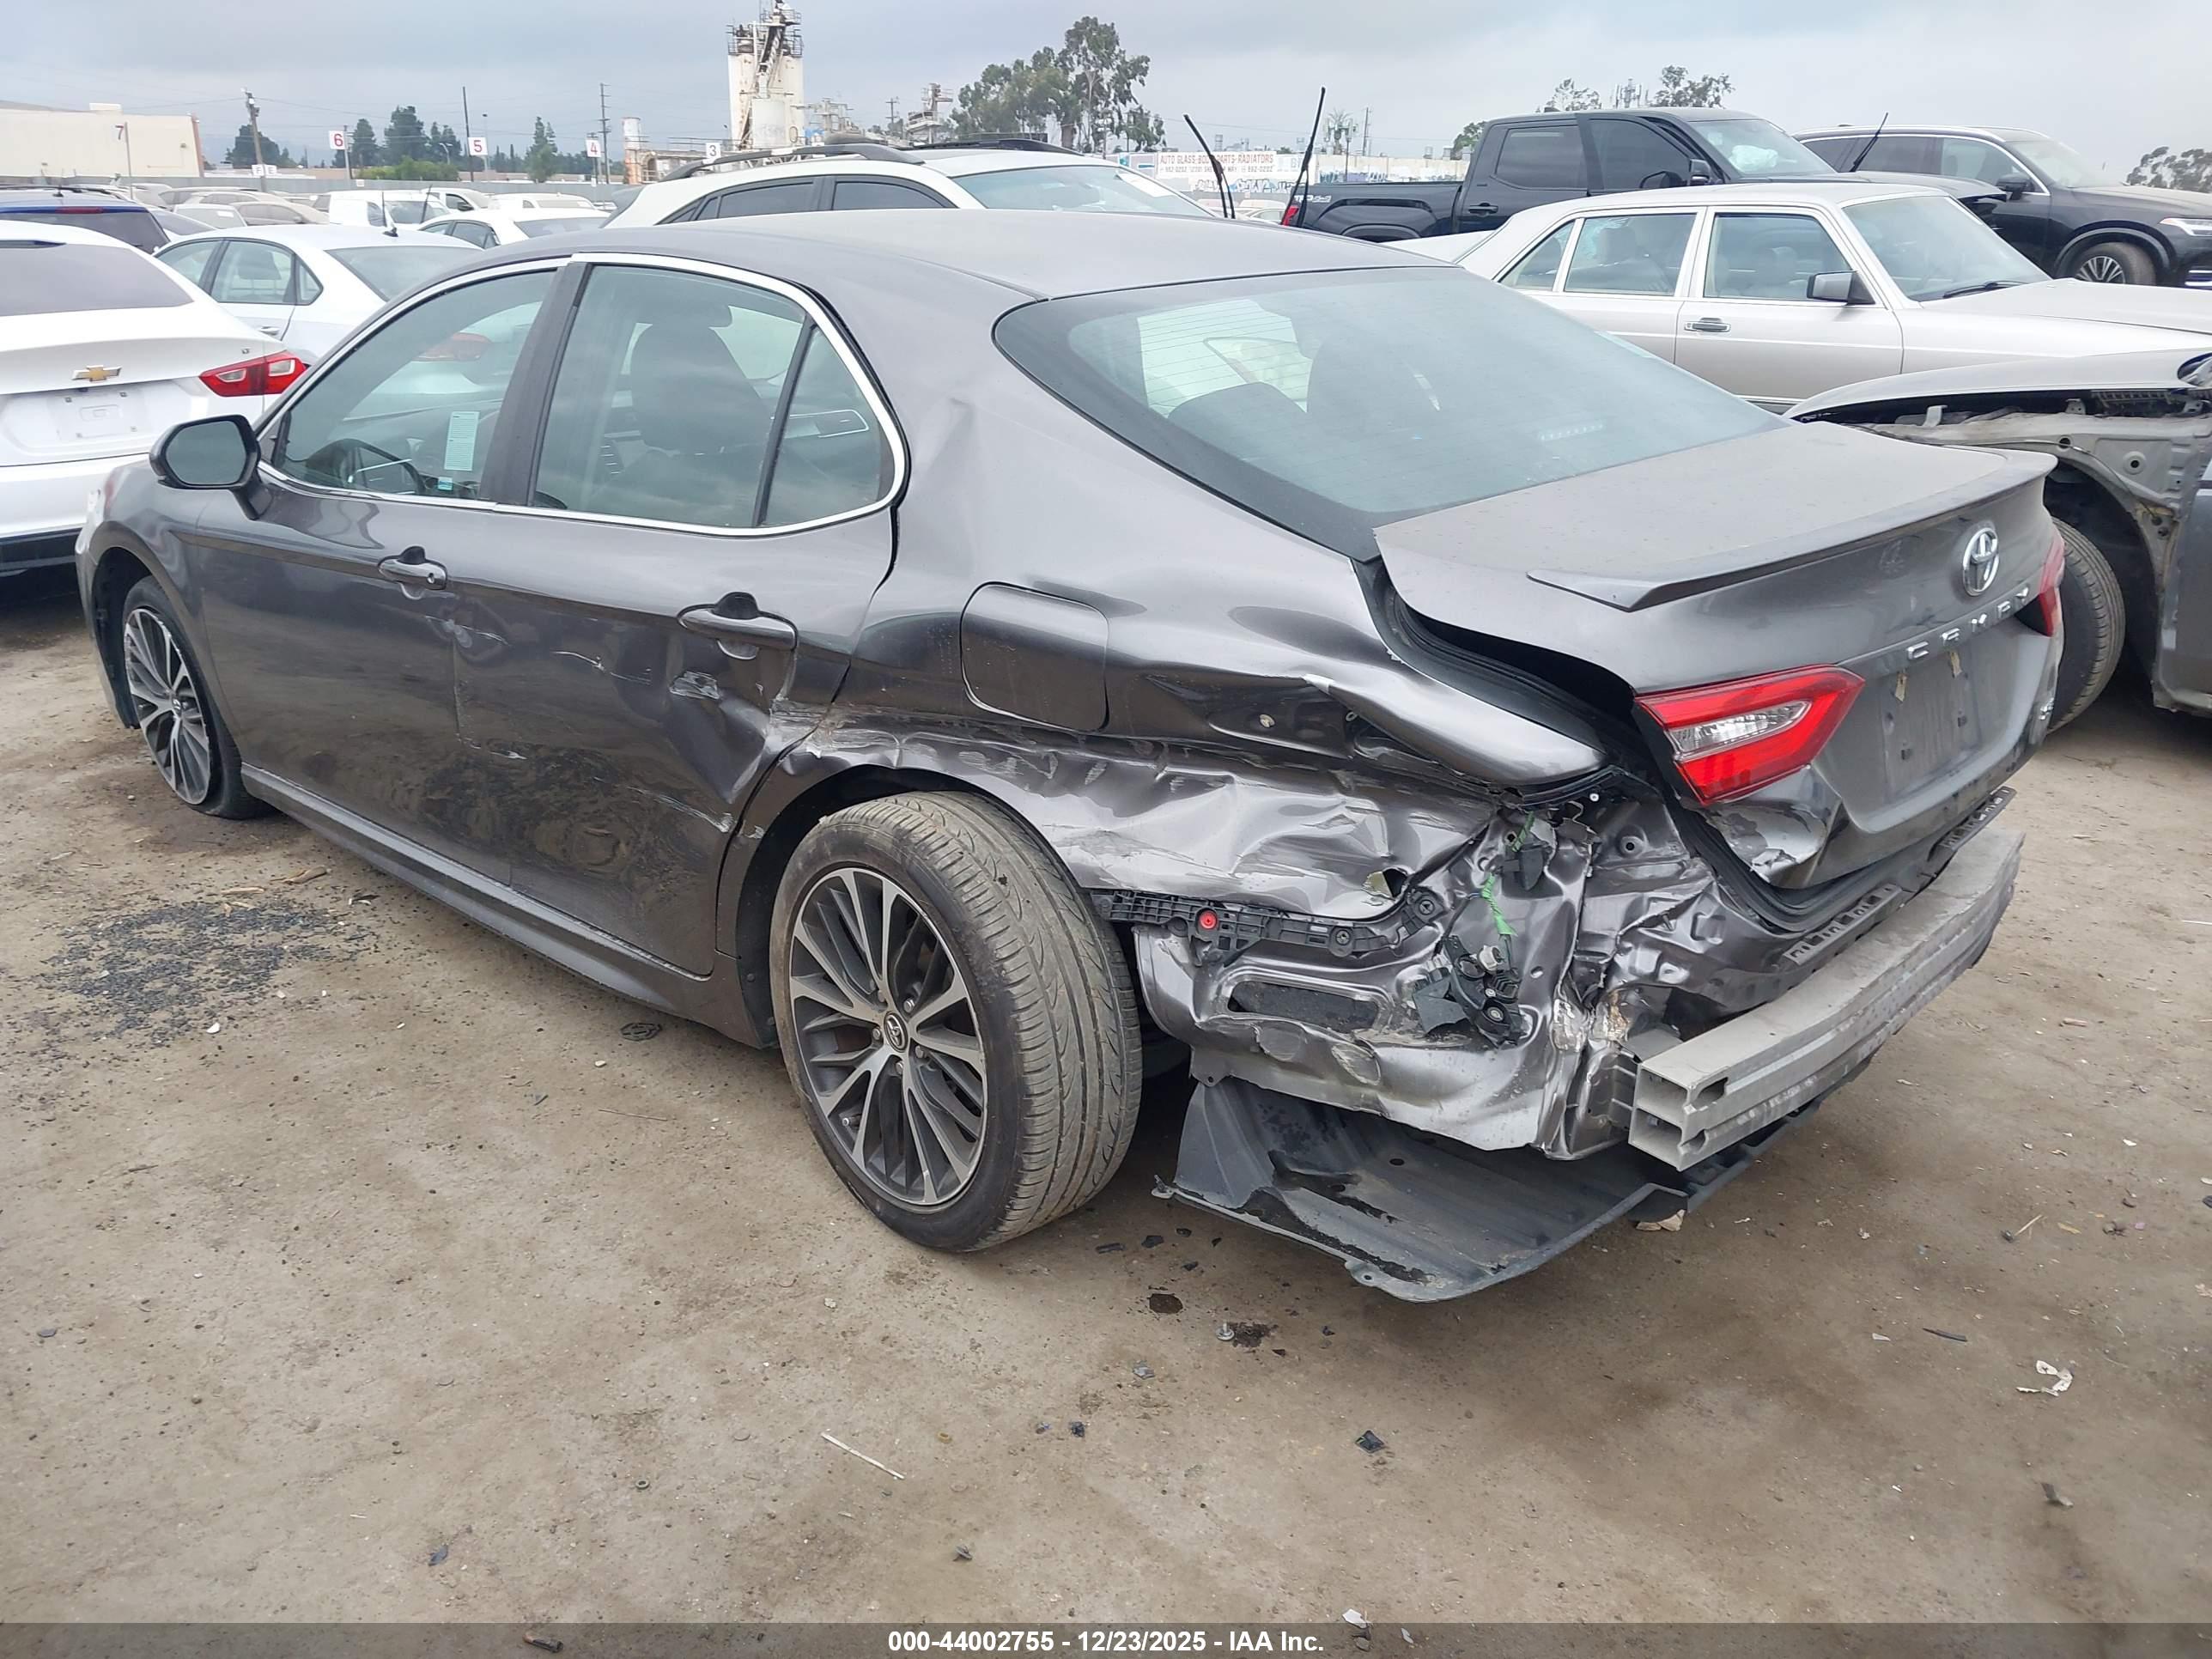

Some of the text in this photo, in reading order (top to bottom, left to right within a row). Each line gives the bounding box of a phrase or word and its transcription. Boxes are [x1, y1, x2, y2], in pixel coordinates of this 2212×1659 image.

[115, 125, 125, 140] 7
[334, 133, 343, 147] 6
[473, 139, 483, 153] 5
[590, 142, 599, 155] 4
[709, 144, 717, 157] 3
